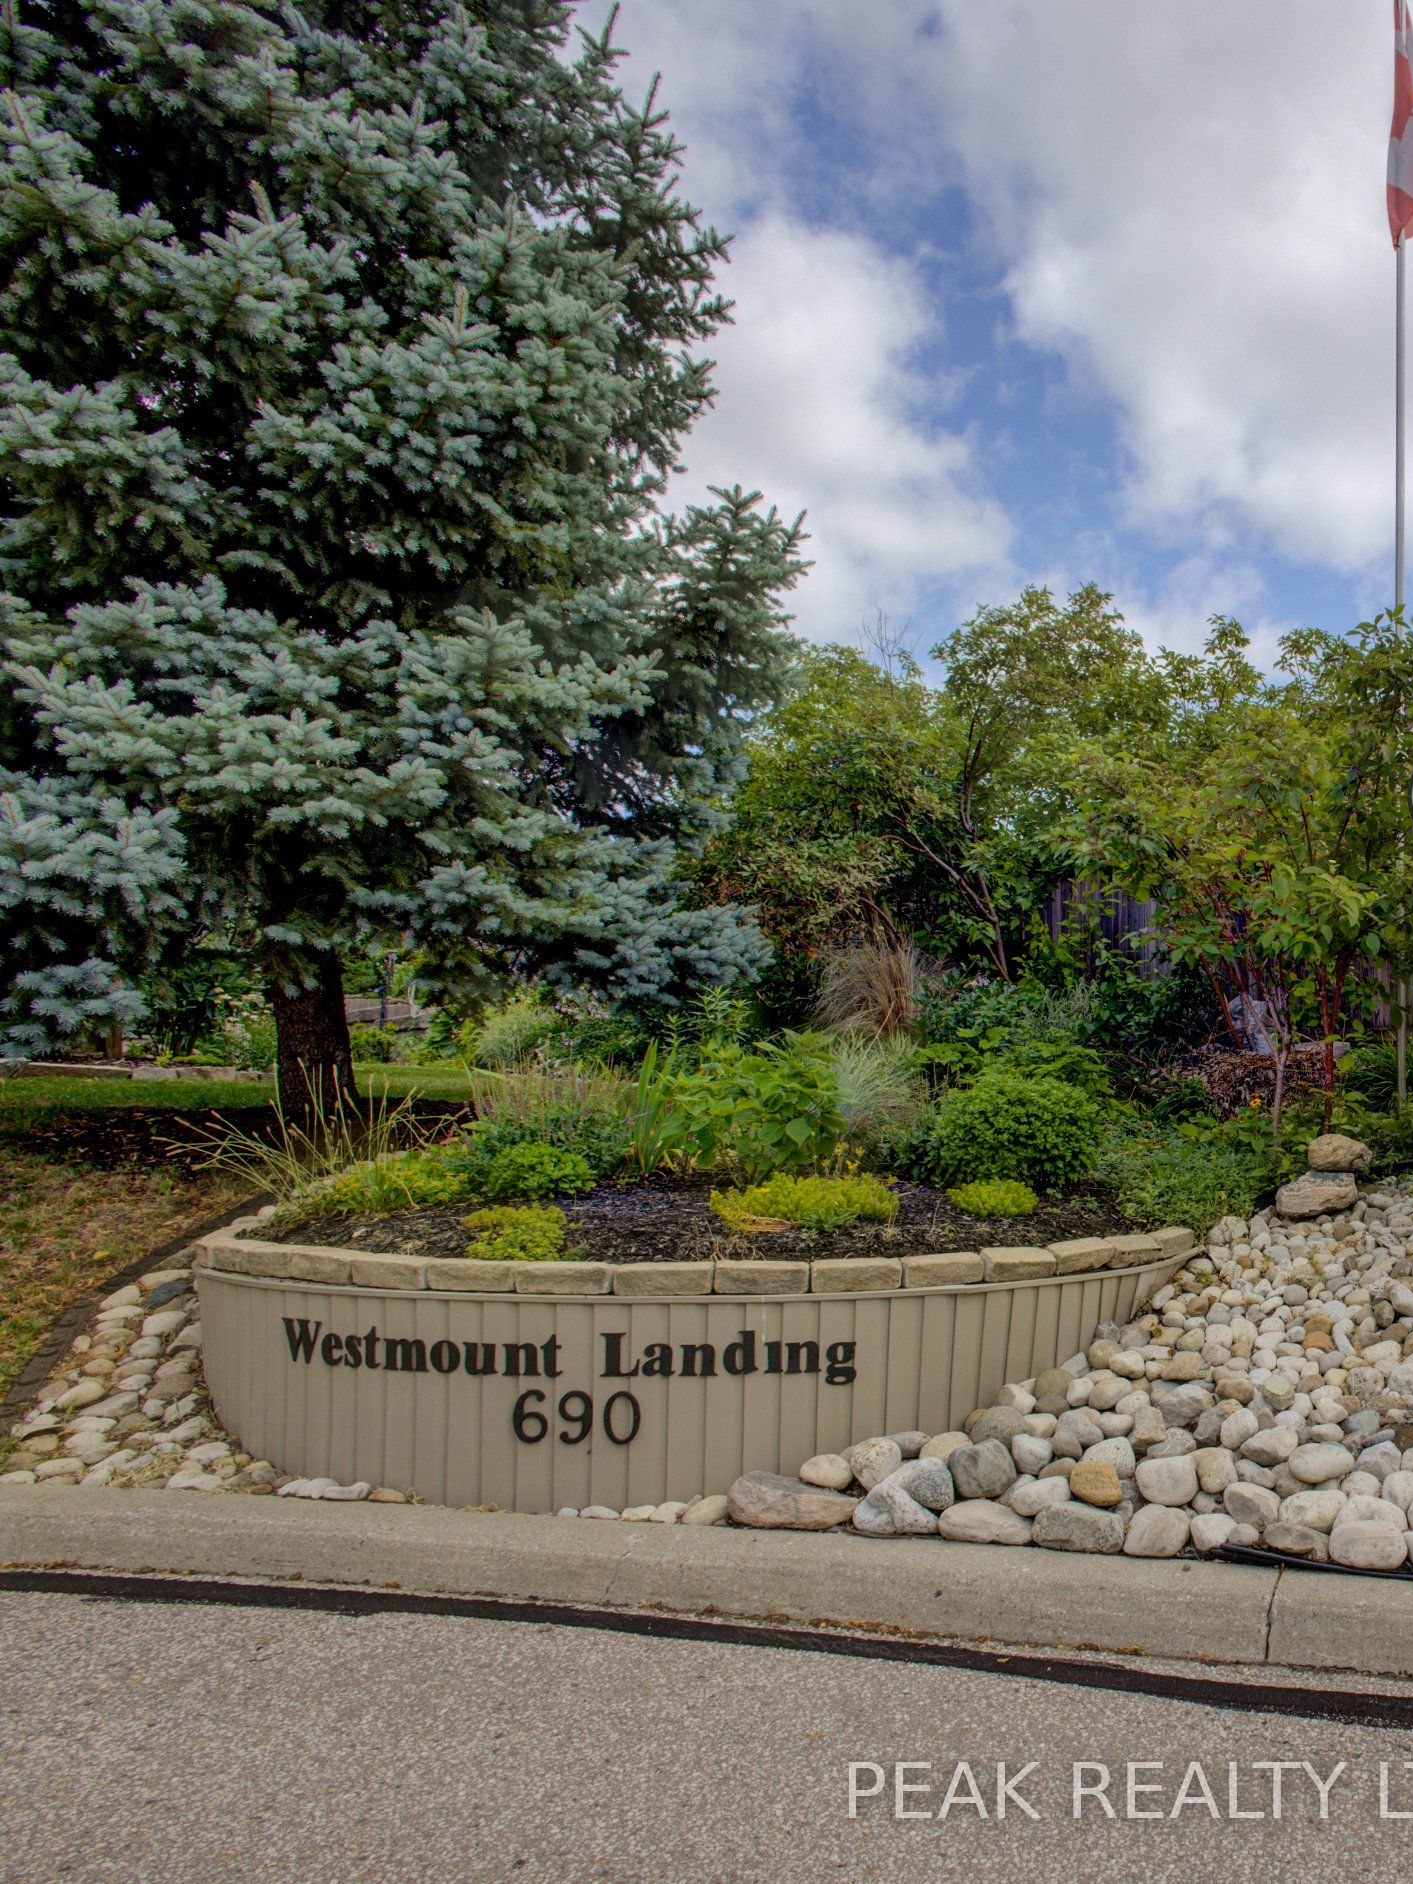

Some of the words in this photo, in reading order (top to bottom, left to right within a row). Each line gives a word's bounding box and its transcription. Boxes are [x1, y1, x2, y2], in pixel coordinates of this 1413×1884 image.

[282, 1317, 563, 1377] Westmount
[600, 1330, 857, 1385] Landing
[512, 1388, 641, 1445] 690
